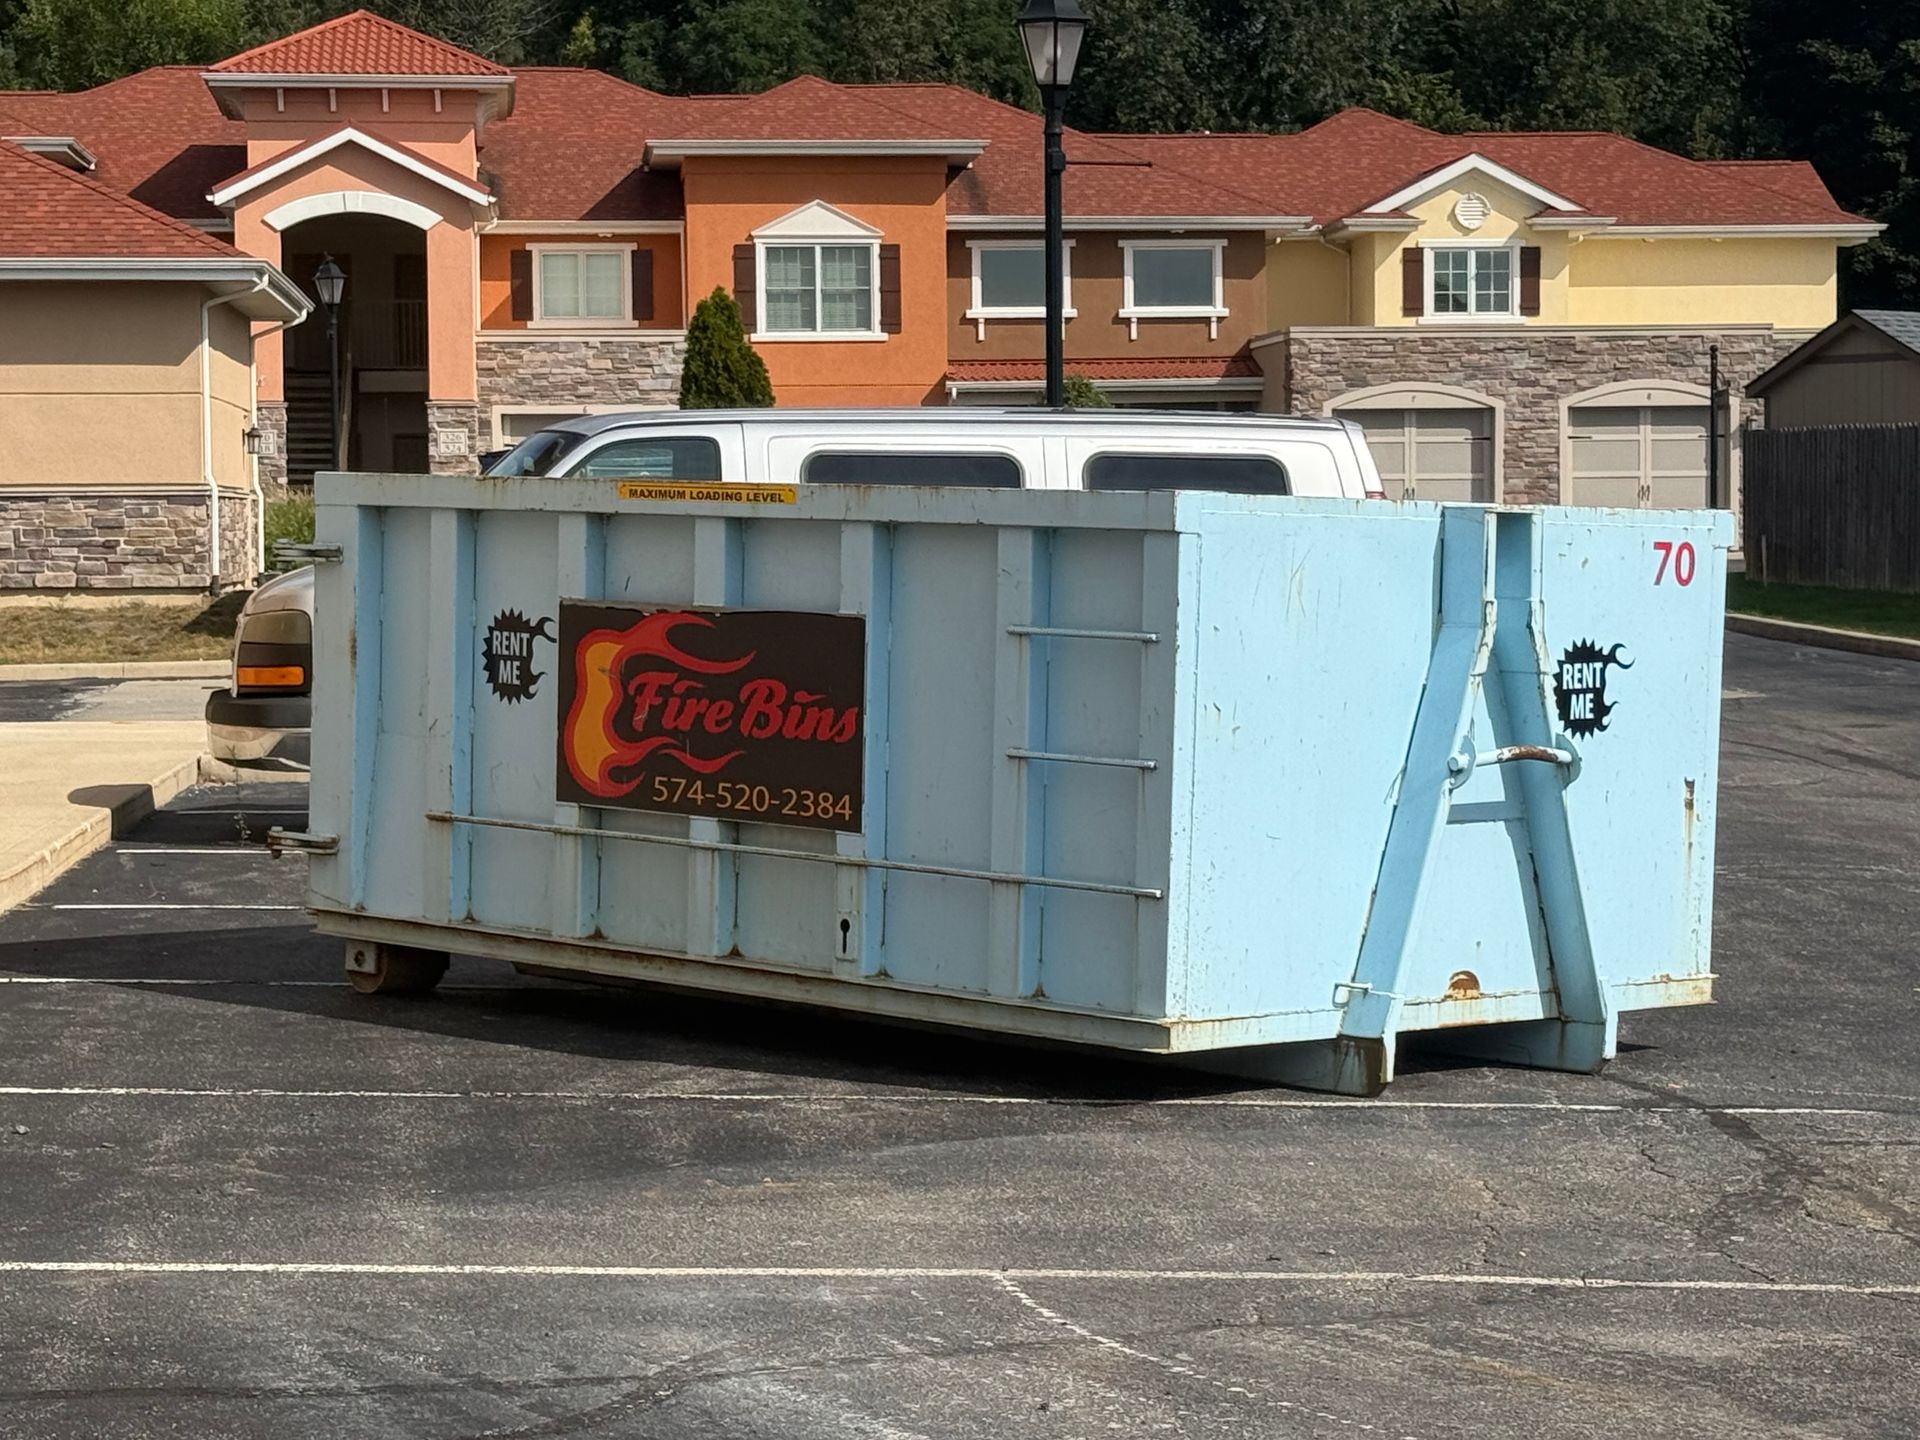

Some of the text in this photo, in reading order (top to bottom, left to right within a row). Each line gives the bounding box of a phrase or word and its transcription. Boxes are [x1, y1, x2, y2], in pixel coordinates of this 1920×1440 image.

[628, 488, 785, 504] MAXIMUM LOADING LEVEL
[1653, 541, 1696, 587] 70
[492, 629, 531, 658] RENT
[498, 659, 521, 685] ME
[1562, 661, 1604, 690] RENT
[627, 671, 859, 744] Fire Bins
[1569, 693, 1595, 720] ME
[651, 775, 853, 821] 574-520-2384
